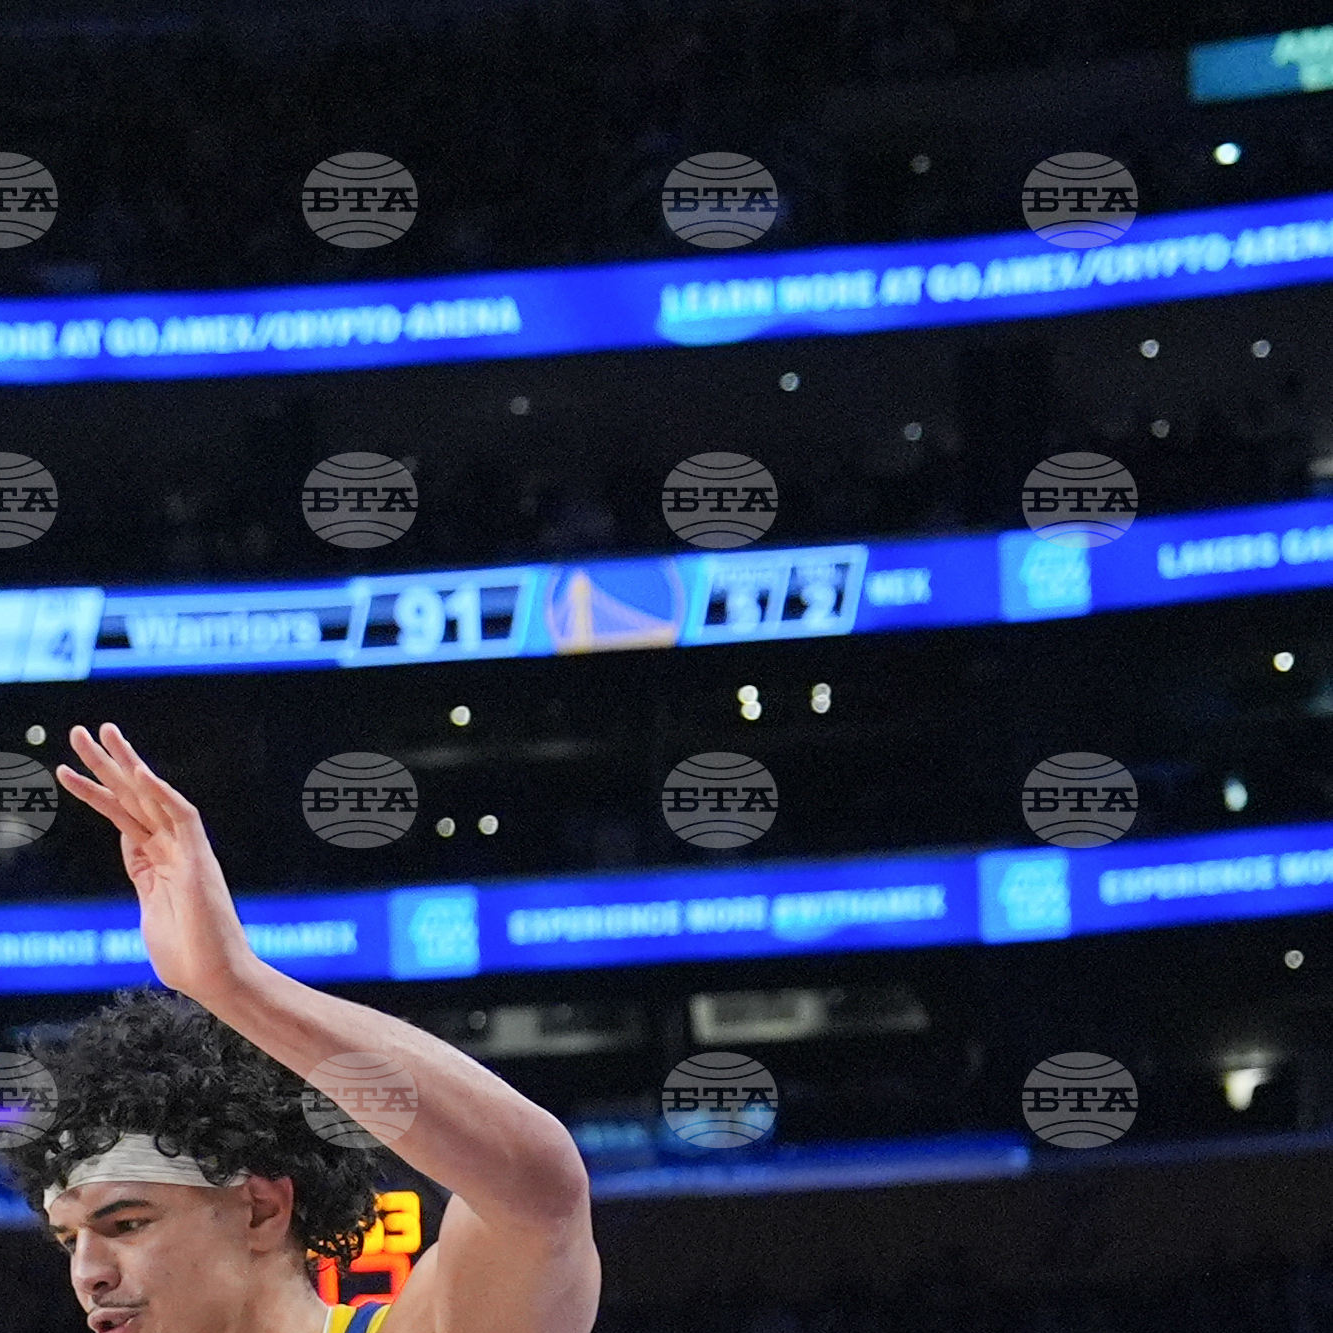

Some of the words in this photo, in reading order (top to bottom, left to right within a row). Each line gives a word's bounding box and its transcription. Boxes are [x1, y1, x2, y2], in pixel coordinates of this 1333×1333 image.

[1157, 532, 1279, 580] LAKERS
[125, 610, 322, 657] Warriors
[393, 584, 483, 656] 91
